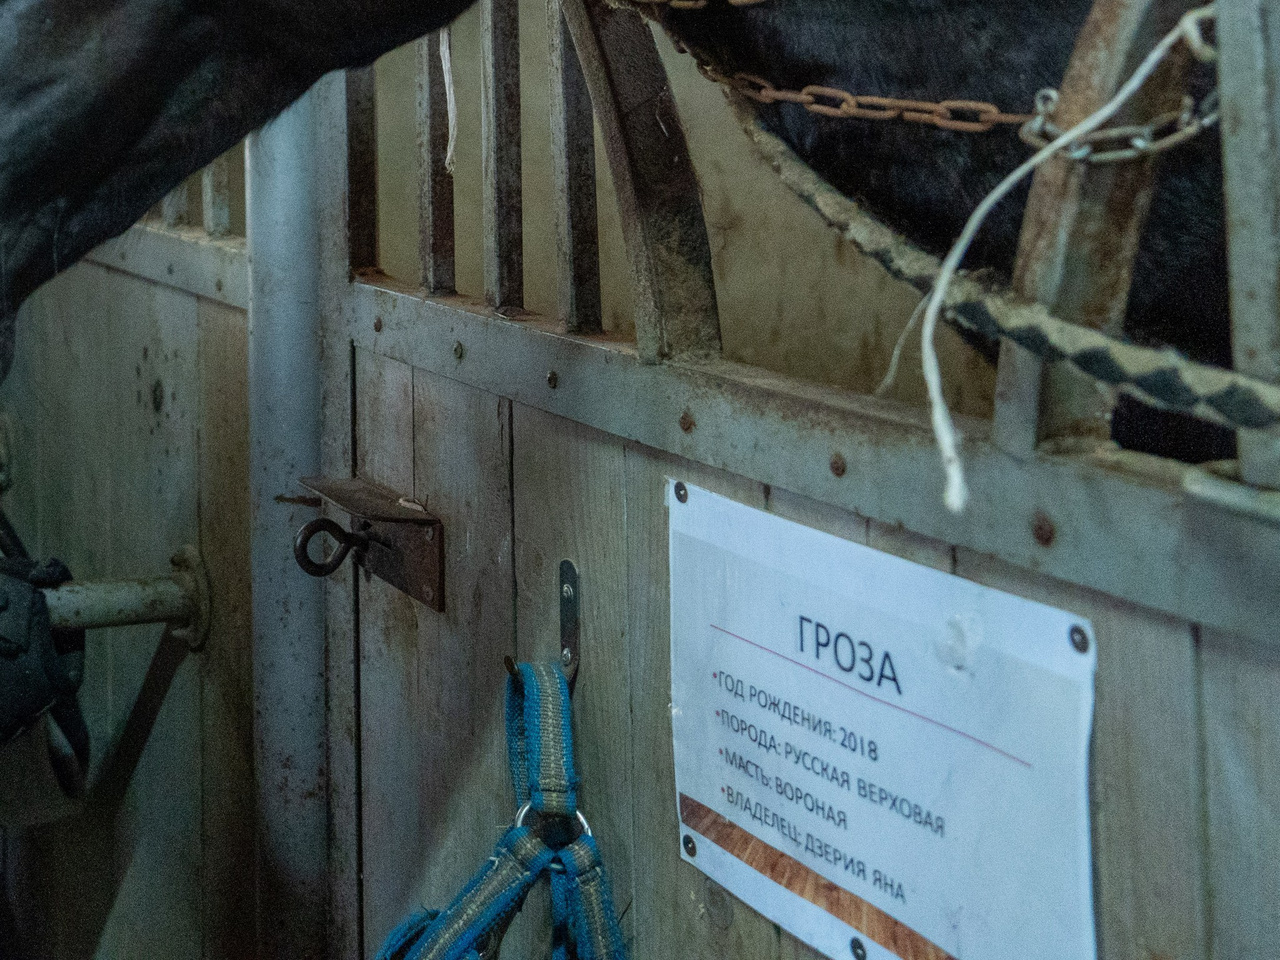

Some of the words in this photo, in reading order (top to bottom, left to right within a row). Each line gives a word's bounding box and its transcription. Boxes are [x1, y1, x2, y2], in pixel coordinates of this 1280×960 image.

[799, 615, 902, 695] ГРОЗА
[719, 671, 745, 700] ГОД
[749, 685, 837, 741] РОЖДЕНИЯ:
[839, 727, 879, 762] 2018
[721, 709, 782, 753] ПОРОДА:
[784, 742, 851, 791] РУССКАЯ
[857, 778, 946, 838] ВЕРХОВАЯ
[724, 747, 773, 788] МАСТЬ:
[775, 777, 848, 829] ВОРОНАЯ
[727, 786, 803, 847] ВЛАДЕЛЕЦ:
[805, 833, 867, 881] ДЗЕРИЯ
[873, 869, 907, 903] ЯНА
